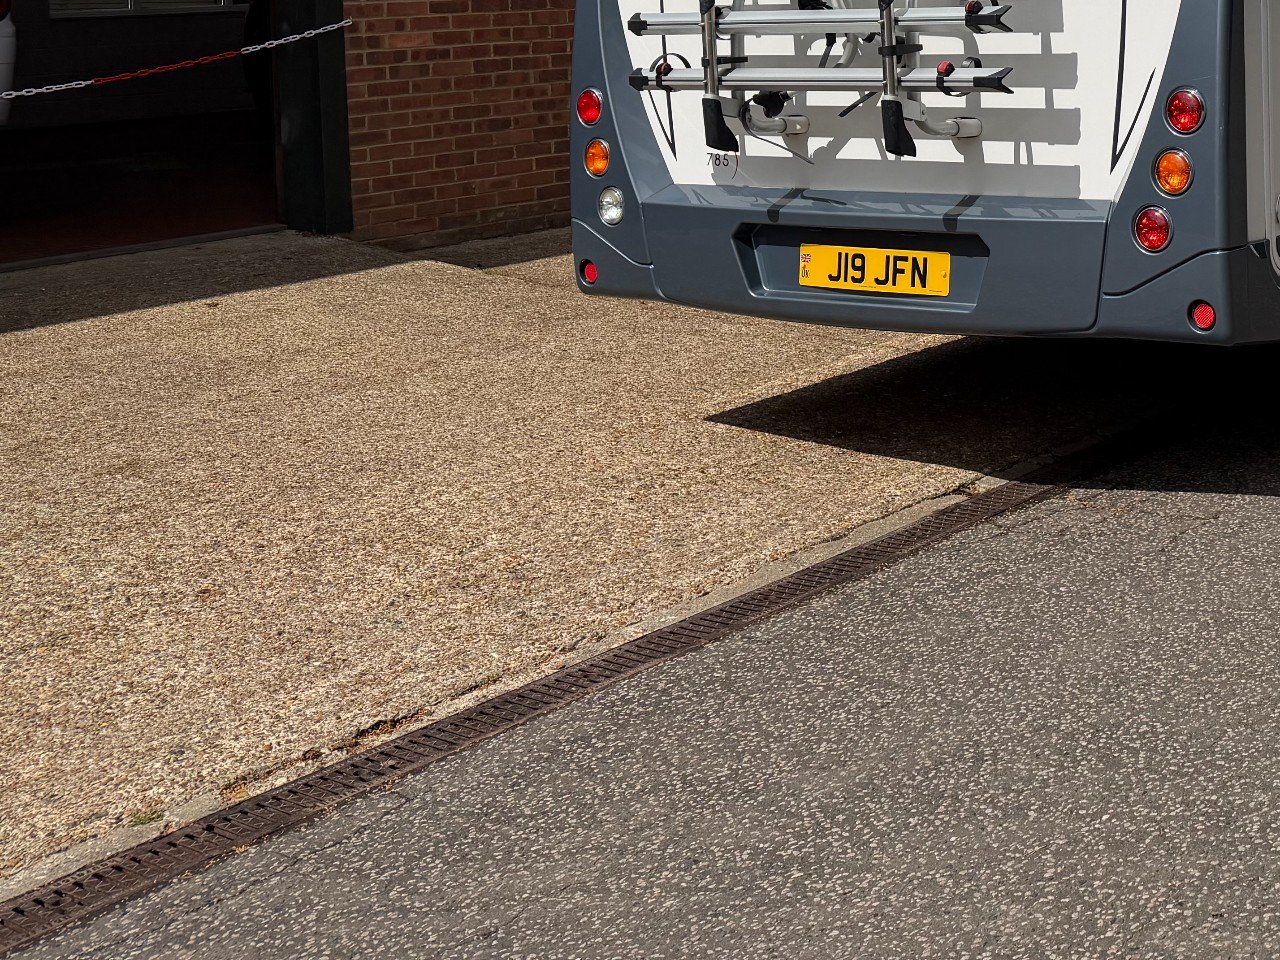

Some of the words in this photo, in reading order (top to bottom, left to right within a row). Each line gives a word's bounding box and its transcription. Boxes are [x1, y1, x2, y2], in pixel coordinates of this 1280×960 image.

[706, 152, 730, 167] 785
[827, 251, 866, 284] J19
[874, 254, 928, 289] JFN
